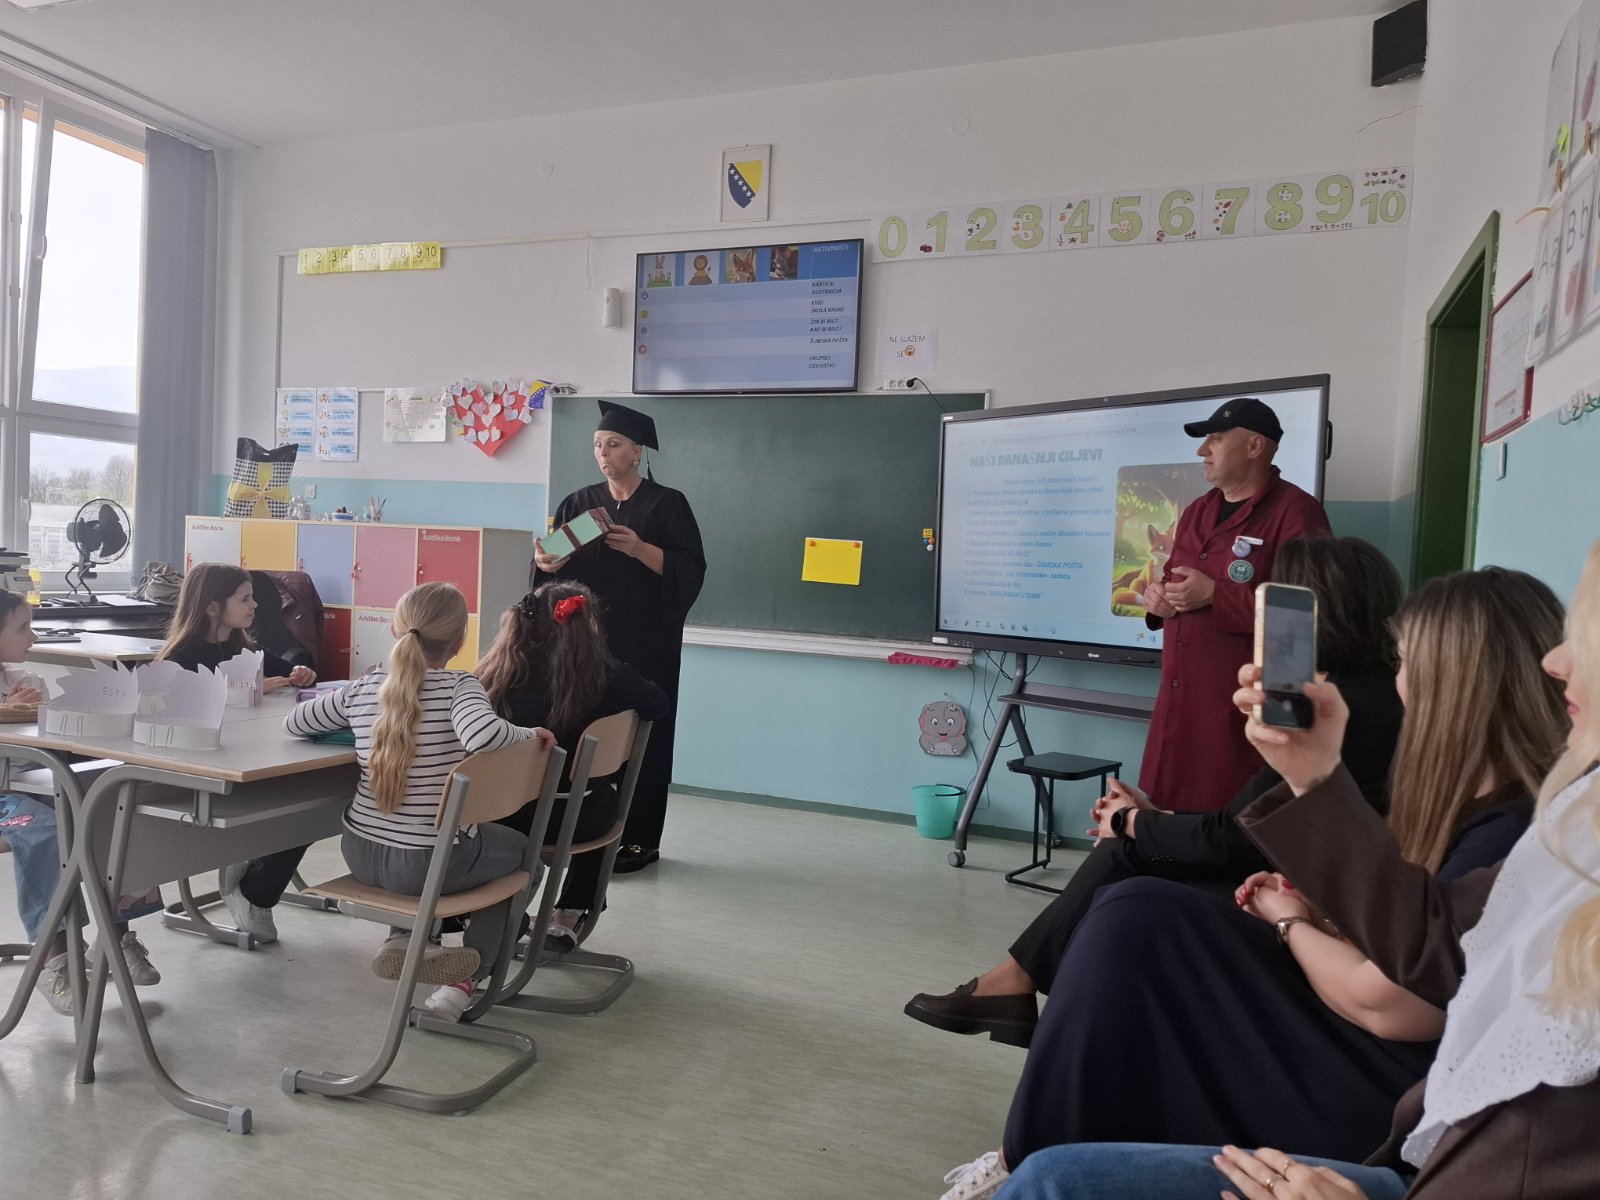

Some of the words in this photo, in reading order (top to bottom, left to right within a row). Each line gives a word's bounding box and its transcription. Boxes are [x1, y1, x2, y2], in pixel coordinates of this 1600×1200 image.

[879, 216, 908, 258] 0
[926, 210, 948, 253] 1
[966, 207, 998, 251] 2
[1011, 204, 1044, 249] 3
[1063, 199, 1094, 244] 4
[1107, 195, 1143, 242] 5
[1158, 189, 1195, 236] 6
[1215, 186, 1250, 235] 7
[1264, 181, 1304, 230] 8
[1315, 174, 1354, 224] 9
[1360, 189, 1406, 225] 10
[813, 244, 849, 253] AKTIVNOSTI
[303, 253, 309, 263] 1
[316, 252, 322, 263] 2
[331, 251, 337, 262] 3
[343, 250, 348, 259] 4
[358, 249, 364, 260] 5
[370, 248, 377, 260] 6
[386, 248, 393, 259] 7
[400, 248, 406, 259] 8
[416, 246, 423, 258] 9
[426, 246, 437, 257] 10
[811, 306, 827, 314] ŠKOLA
[810, 317, 819, 325] ŠTA
[810, 336, 831, 344] ŠUMSKA
[899, 334, 926, 343] SLAŽEM
[896, 350, 904, 358] SE
[969, 454, 995, 468] NAŠI
[998, 450, 1056, 466] DANAŠNJI
[1058, 448, 1103, 462] CILJEVI
[445, 534, 462, 542] Bank
[1036, 560, 1061, 569] ŠUMSKA
[1063, 561, 1083, 569] POŠTA
